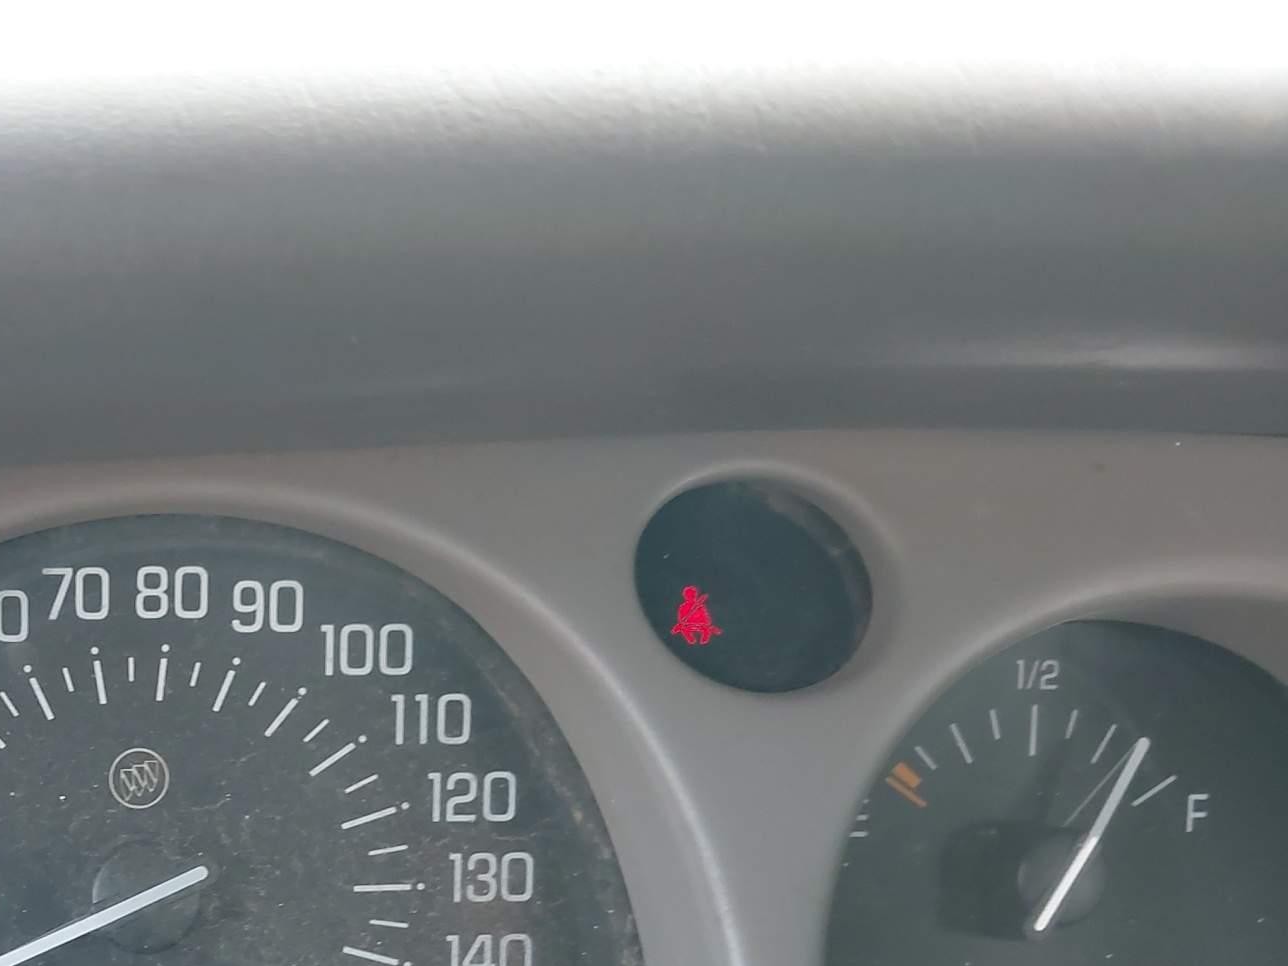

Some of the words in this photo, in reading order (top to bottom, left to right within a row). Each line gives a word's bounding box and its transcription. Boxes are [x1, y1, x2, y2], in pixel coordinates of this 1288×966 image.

[42, 566, 110, 620] 70
[135, 565, 209, 619] 80
[231, 579, 304, 633] 90
[320, 623, 413, 676] 100
[1016, 659, 1059, 690] 1/2
[390, 693, 472, 745] 110
[427, 771, 517, 823] 120
[1186, 793, 1209, 833] F
[448, 851, 534, 903] 130
